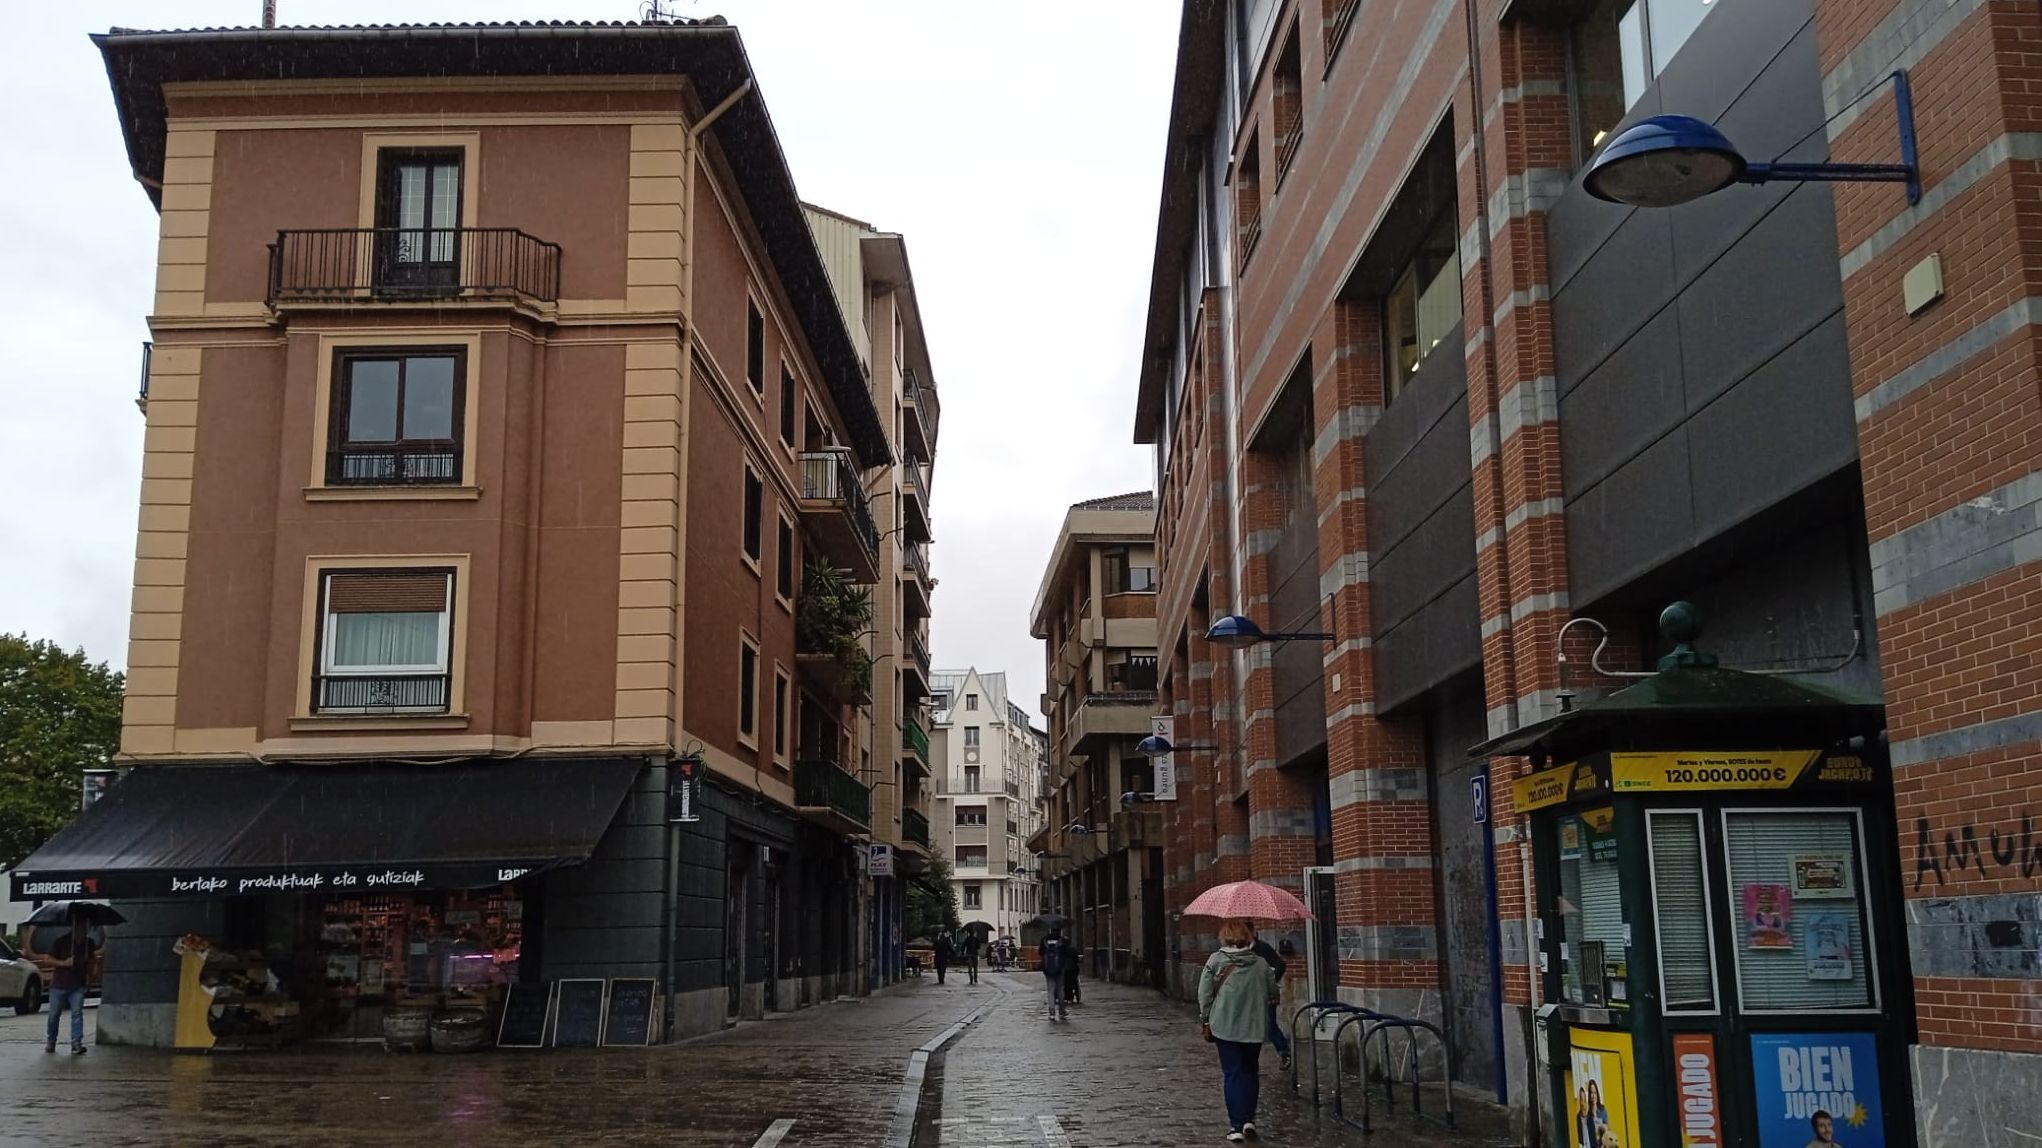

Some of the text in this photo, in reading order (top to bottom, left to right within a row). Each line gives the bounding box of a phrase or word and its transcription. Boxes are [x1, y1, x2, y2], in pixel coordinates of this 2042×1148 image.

[1664, 767, 1786, 784] 120.000.000€
[171, 869, 425, 895] bertako produktuak eta gutiziak
[1778, 1046, 1854, 1092] BIEN
[1679, 1053, 1716, 1139] JUGADO
[1784, 1092, 1856, 1119] JUGADO
